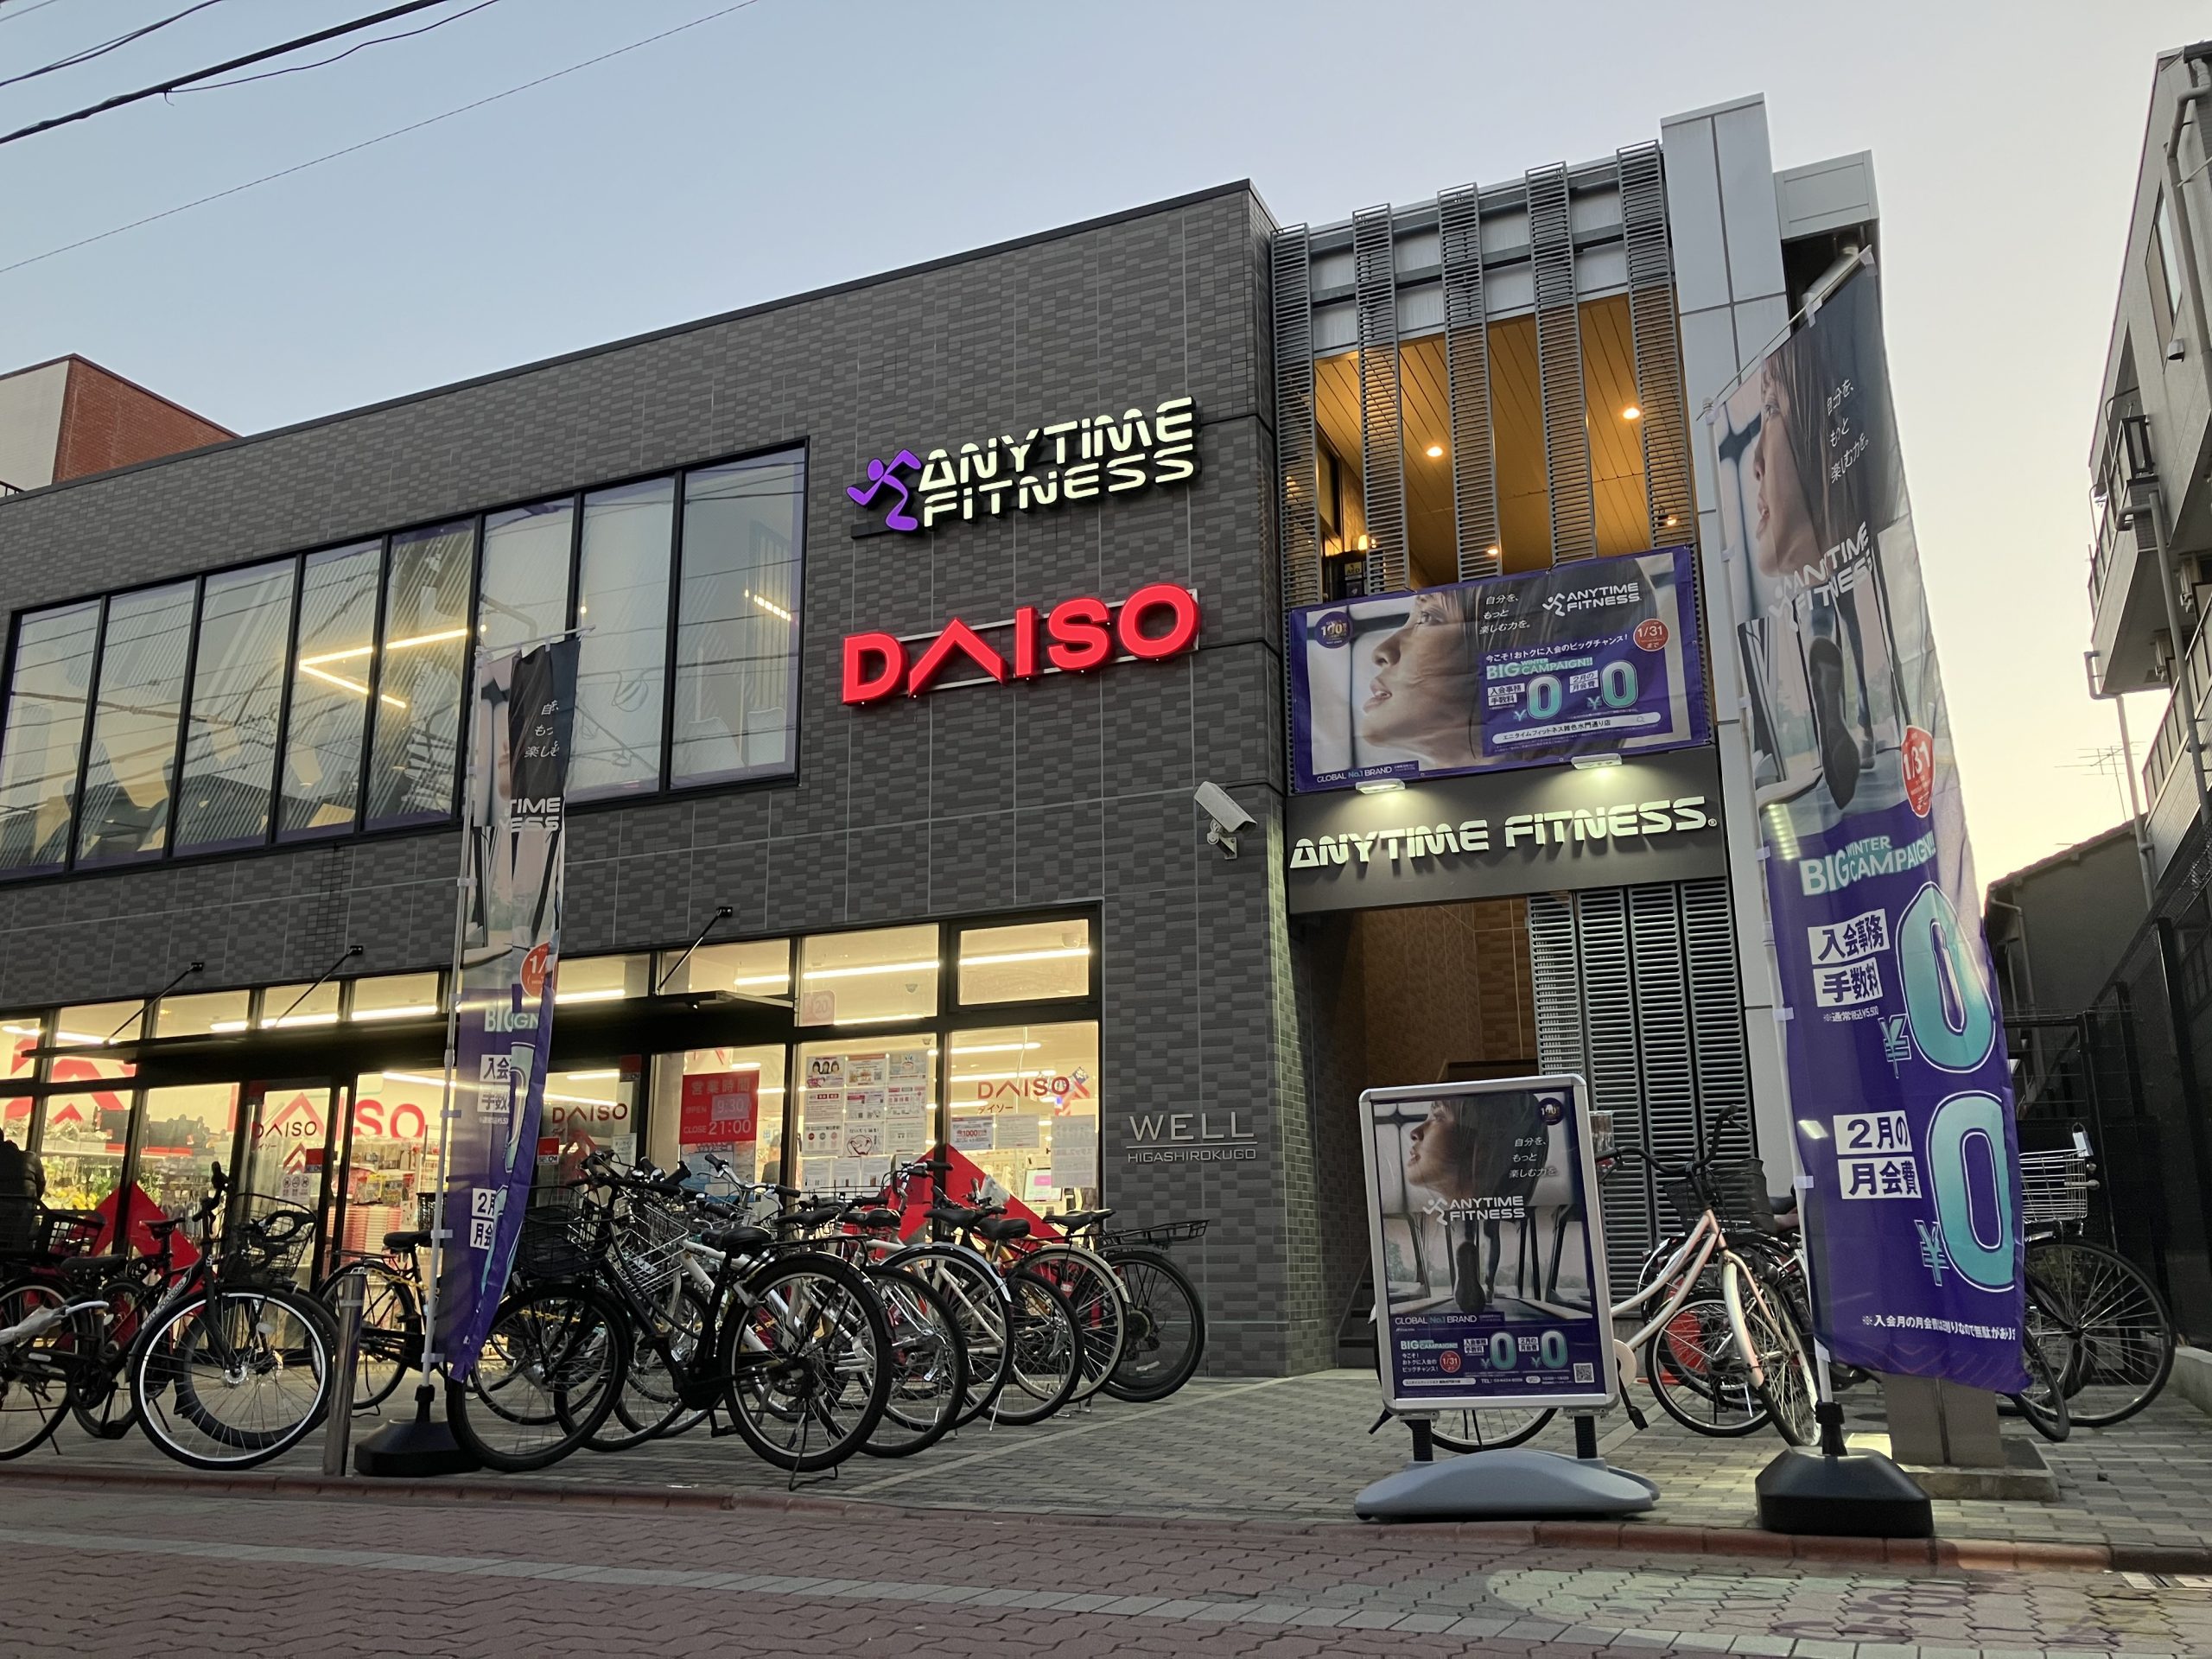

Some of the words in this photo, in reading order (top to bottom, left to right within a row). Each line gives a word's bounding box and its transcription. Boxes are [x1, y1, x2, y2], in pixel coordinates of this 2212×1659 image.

[918, 396, 1193, 493] ANYTIME
[923, 443, 1194, 529] FITNESS
[1567, 582, 1639, 602] ANYTIME
[1567, 592, 1641, 613] FITNESS
[1483, 609, 1510, 620] もっと
[1637, 625, 1663, 639] 1/31
[842, 582, 1198, 705] DAISO
[1486, 661, 1522, 681] BIG
[1521, 658, 1549, 666] WINTER
[1316, 772, 1347, 784] GLOBAL
[1364, 766, 1393, 778] BRAND
[1288, 818, 1491, 870] ANYTIME
[1504, 795, 1707, 849] FITNESS
[1846, 835, 1893, 859] WINTER
[1799, 849, 1851, 897] BIG
[977, 1076, 1070, 1100] DAISO
[552, 1103, 628, 1124] DAISO
[685, 1105, 707, 1115] OPEN
[717, 1098, 744, 1114] 9:30
[977, 1103, 1014, 1115] ダイソー
[252, 1121, 317, 1139] DAISO
[683, 1125, 707, 1135] CLOSE
[708, 1120, 752, 1135] 21:00
[1128, 1111, 1255, 1141] WELL
[1847, 1116, 1909, 1150] 2月の
[1515, 1136, 1547, 1147] 自分を、
[1128, 1148, 1256, 1164] HIGASHIROKUGO
[1512, 1152, 1538, 1163] もっと
[1847, 1160, 1919, 1196] 月会費
[1449, 1195, 1524, 1211] ANYTIME
[1450, 1208, 1526, 1222] FITNESS
[1395, 1317, 1428, 1325] GLOBAL
[1446, 1314, 1478, 1324] BRAND
[1400, 1340, 1420, 1350] BIG
